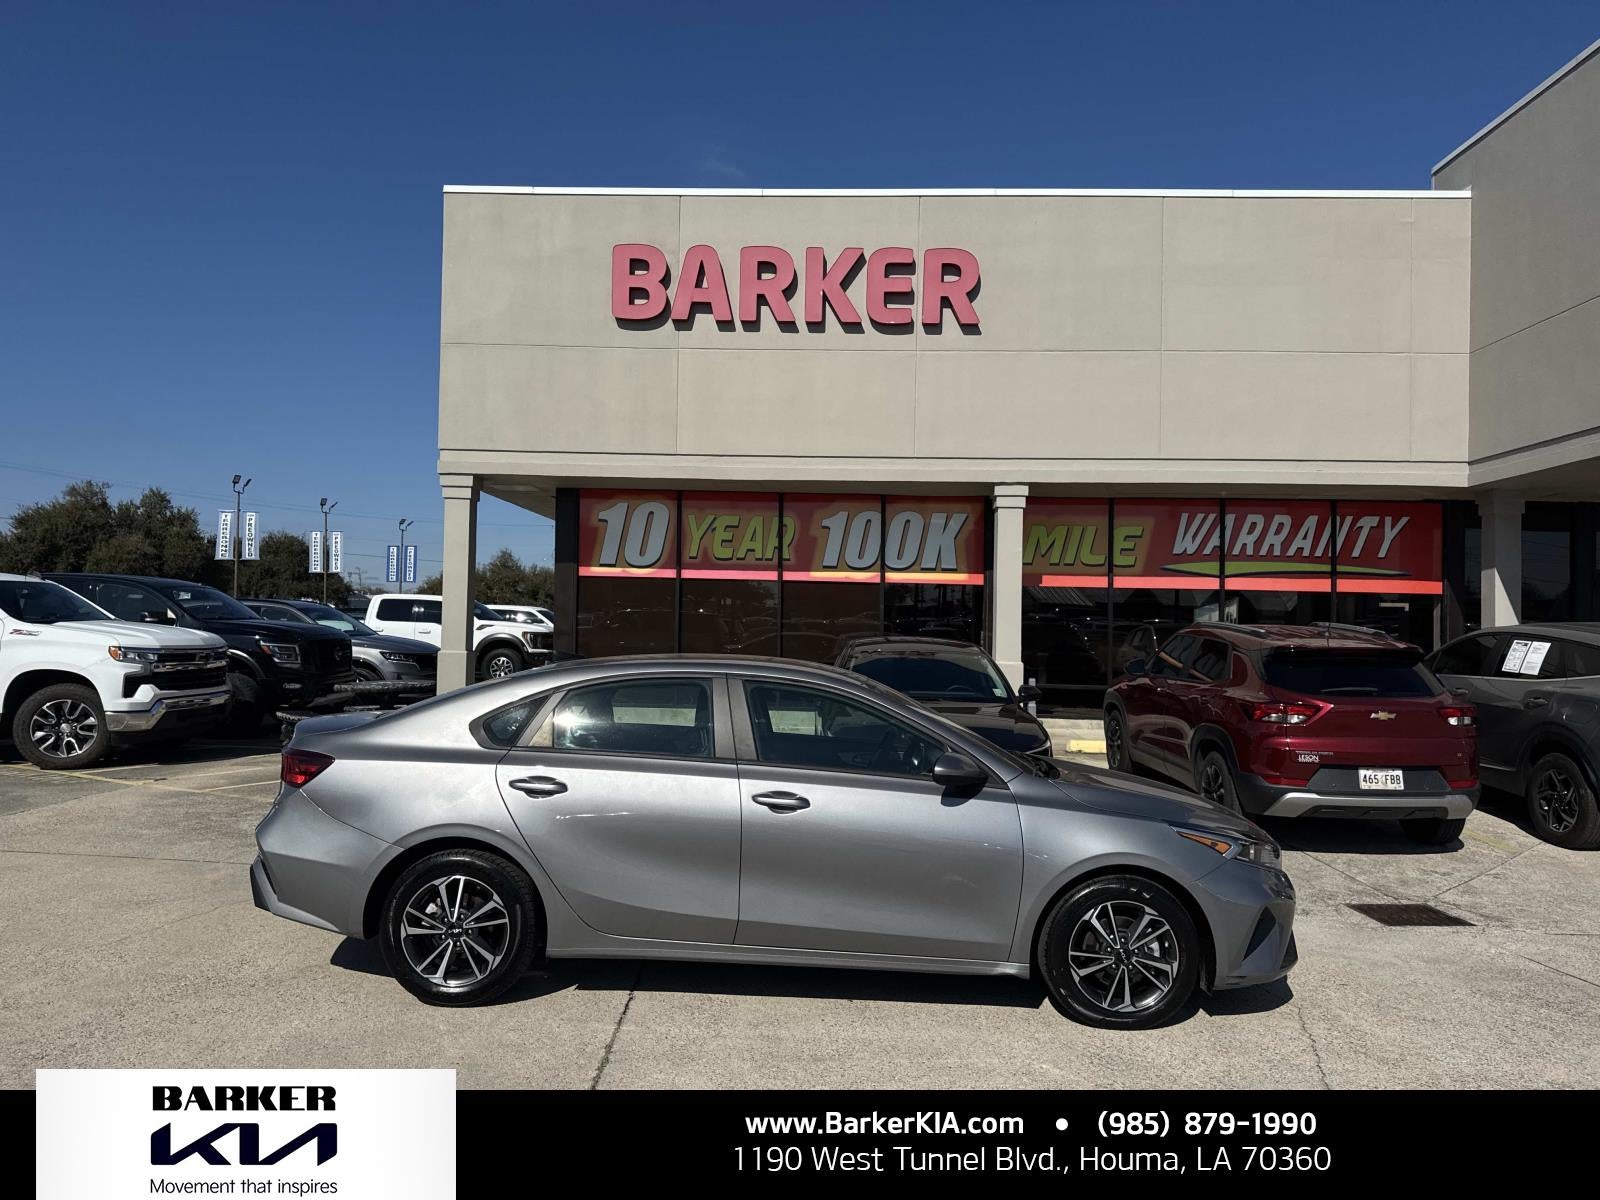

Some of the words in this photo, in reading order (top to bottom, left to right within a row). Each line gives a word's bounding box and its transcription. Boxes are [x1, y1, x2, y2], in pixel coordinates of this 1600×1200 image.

[611, 243, 981, 325] BARKER
[598, 502, 671, 567] 10
[688, 514, 796, 561] YEAR
[821, 511, 968, 571] 100K
[1023, 524, 1144, 567] MILE
[1172, 512, 1411, 559] WARRANTY
[1362, 774, 1380, 785] 465
[1384, 774, 1402, 785] FBB
